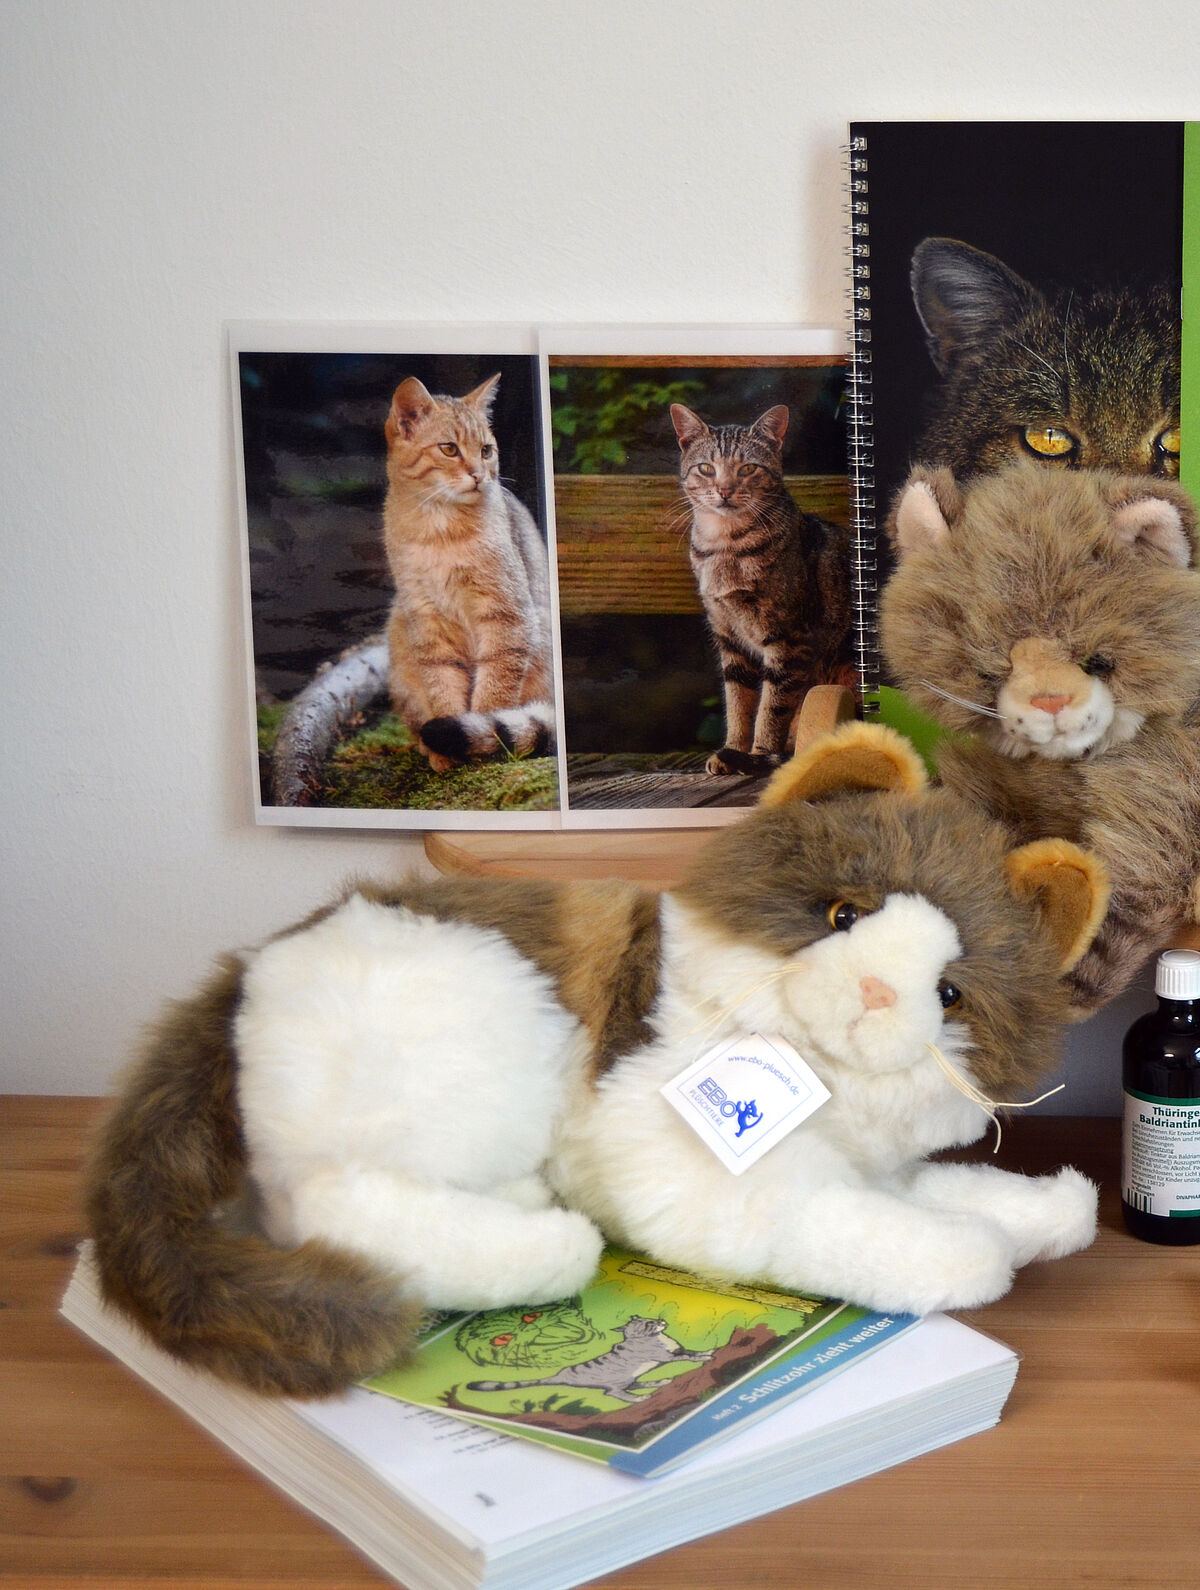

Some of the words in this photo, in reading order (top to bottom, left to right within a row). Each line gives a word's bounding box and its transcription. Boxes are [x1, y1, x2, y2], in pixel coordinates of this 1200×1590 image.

[697, 1076, 737, 1118] EBO
[739, 1361, 817, 1404] Schlitzohr
[813, 1340, 855, 1364] zieht
[848, 1316, 896, 1347] weiter
